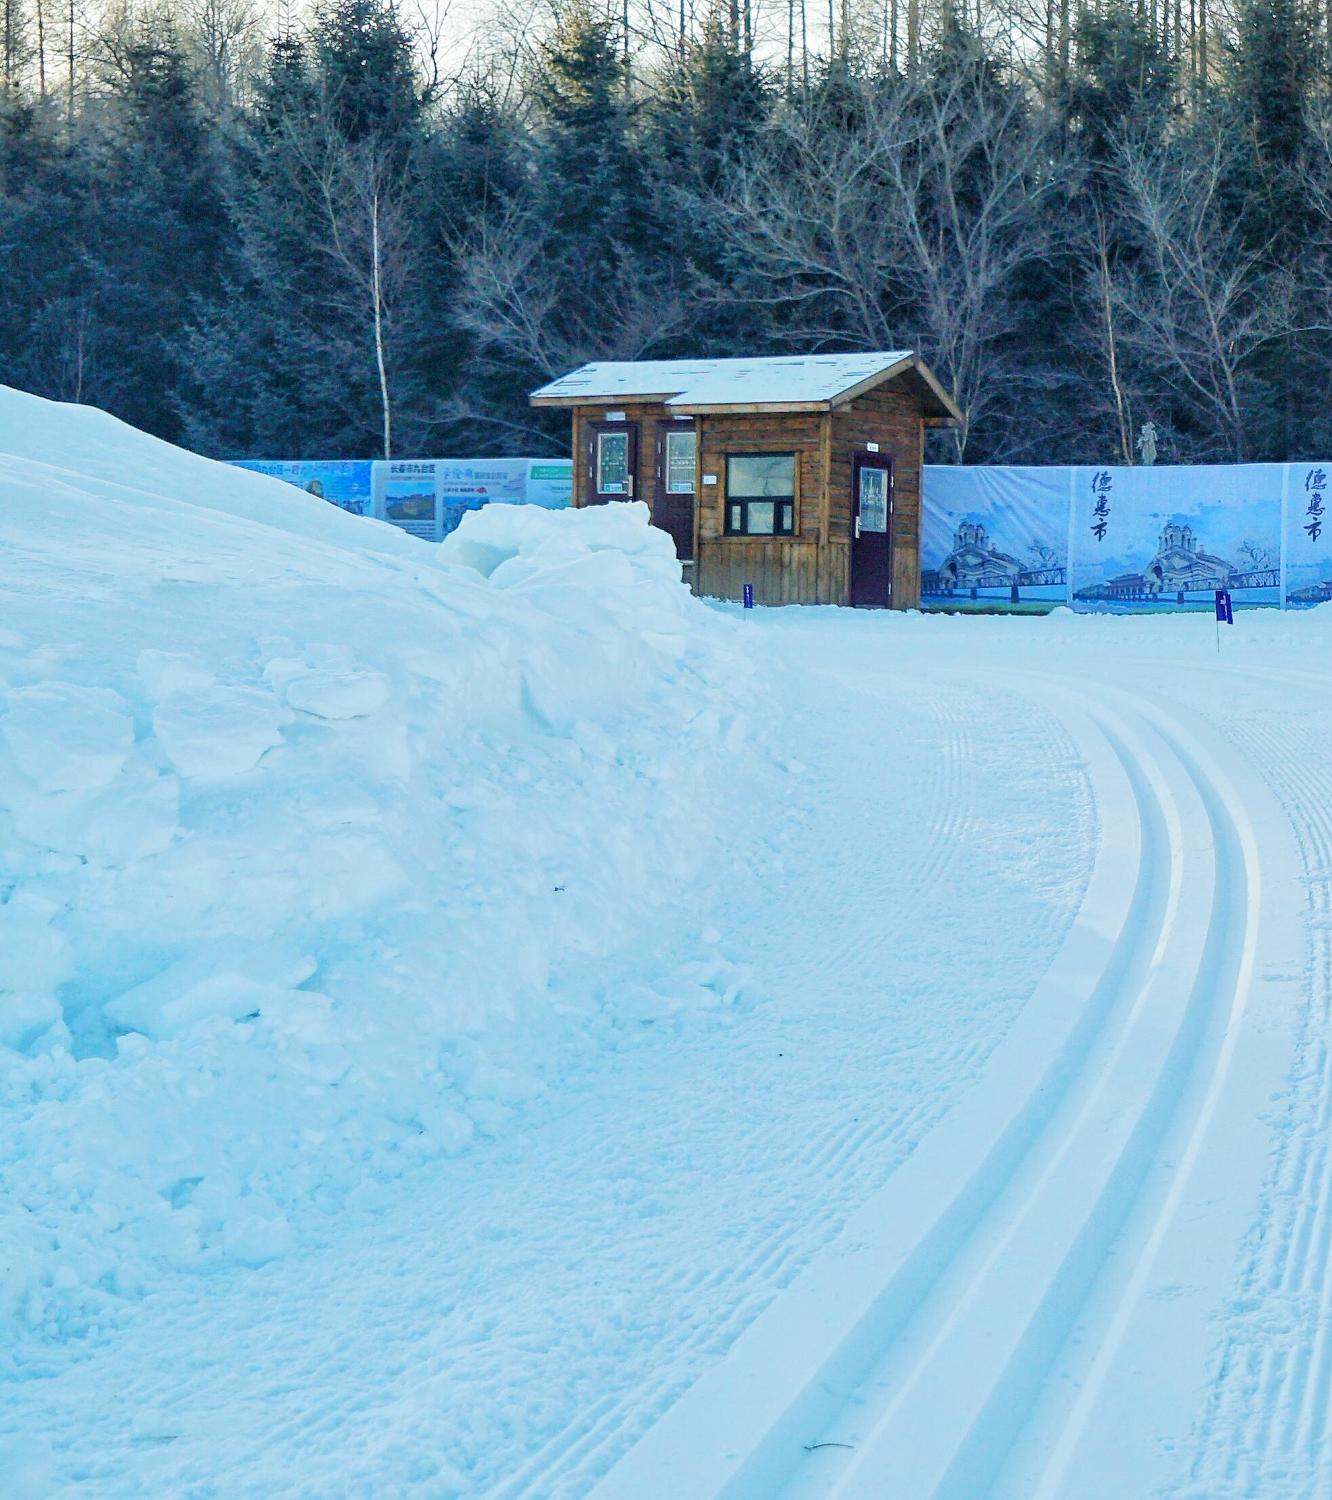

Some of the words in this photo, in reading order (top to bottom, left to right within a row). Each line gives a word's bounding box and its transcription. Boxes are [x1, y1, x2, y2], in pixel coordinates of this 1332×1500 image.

[1091, 471, 1113, 542] 德惠市
[1303, 468, 1328, 543] 德惠市
